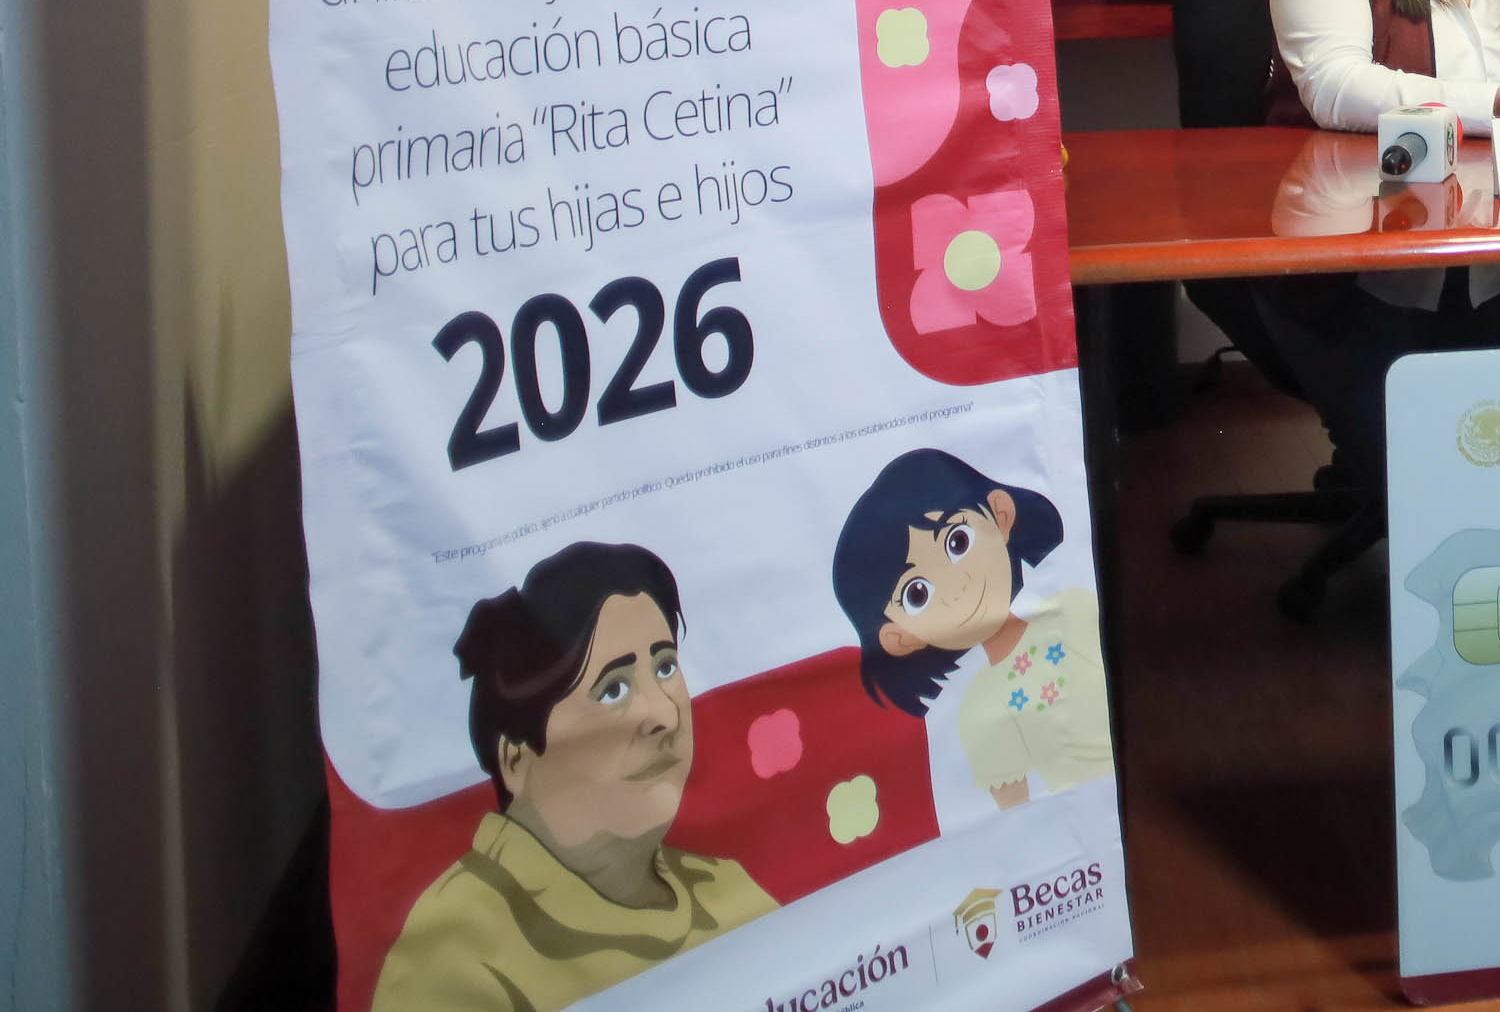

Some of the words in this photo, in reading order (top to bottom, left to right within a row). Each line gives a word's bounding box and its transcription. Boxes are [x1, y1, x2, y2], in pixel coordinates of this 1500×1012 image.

[384, 11, 601, 91] educación
[615, 7, 752, 64] básica
[350, 112, 526, 205] primaria
[369, 223, 458, 295] para
[469, 203, 540, 256] tus
[548, 183, 644, 252] hijas
[656, 181, 683, 222] e
[694, 160, 795, 226] hijos
[430, 256, 755, 472] 2026
[1010, 862, 1102, 917] Becas
[1016, 887, 1104, 933] BIENESTAR
[766, 944, 909, 1012] ucación
